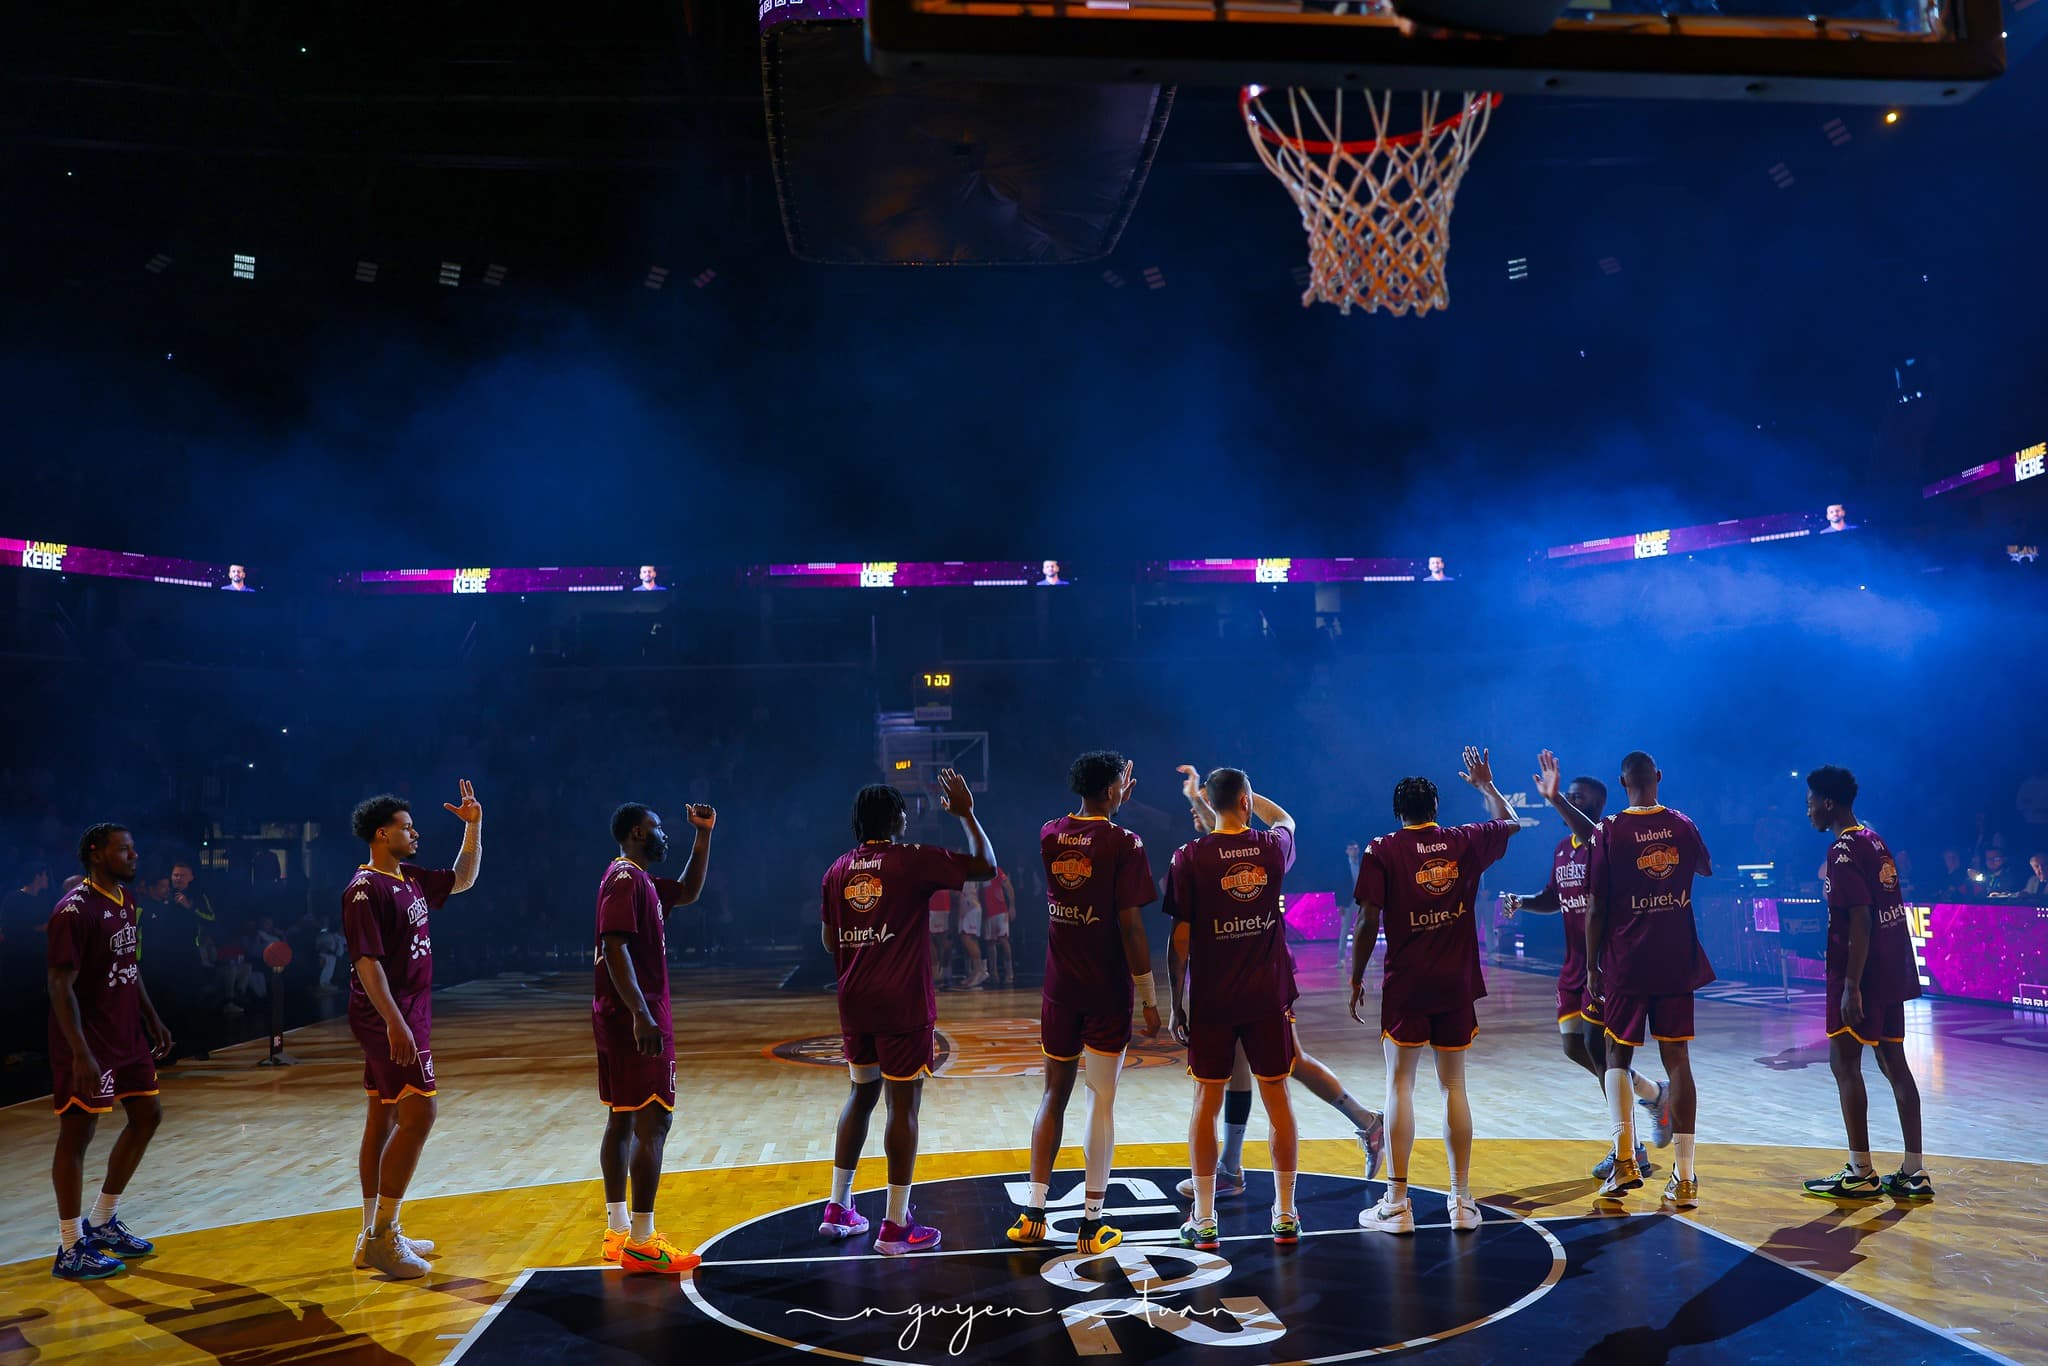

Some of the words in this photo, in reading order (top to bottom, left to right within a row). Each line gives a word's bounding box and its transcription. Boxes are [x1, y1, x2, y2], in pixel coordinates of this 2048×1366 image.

[2014, 455, 2045, 482] KEBE
[26, 540, 67, 556] LAMINE
[1634, 540, 1668, 559] KEBE
[22, 550, 62, 571] KEBE
[453, 577, 487, 593] KEBE
[860, 571, 894, 587] KEBE
[1057, 832, 1092, 846] Nicolas
[1634, 827, 1673, 842] Ludovic
[1218, 847, 1261, 859] Lorenzo
[1416, 842, 1448, 854] Maceo
[848, 858, 882, 870] Anthony
[1631, 892, 1673, 909] Loiret
[1048, 902, 1080, 919] oiret
[1409, 909, 1449, 927] Loire
[1213, 915, 1262, 934] Loiret
[838, 926, 875, 942] Loiret
